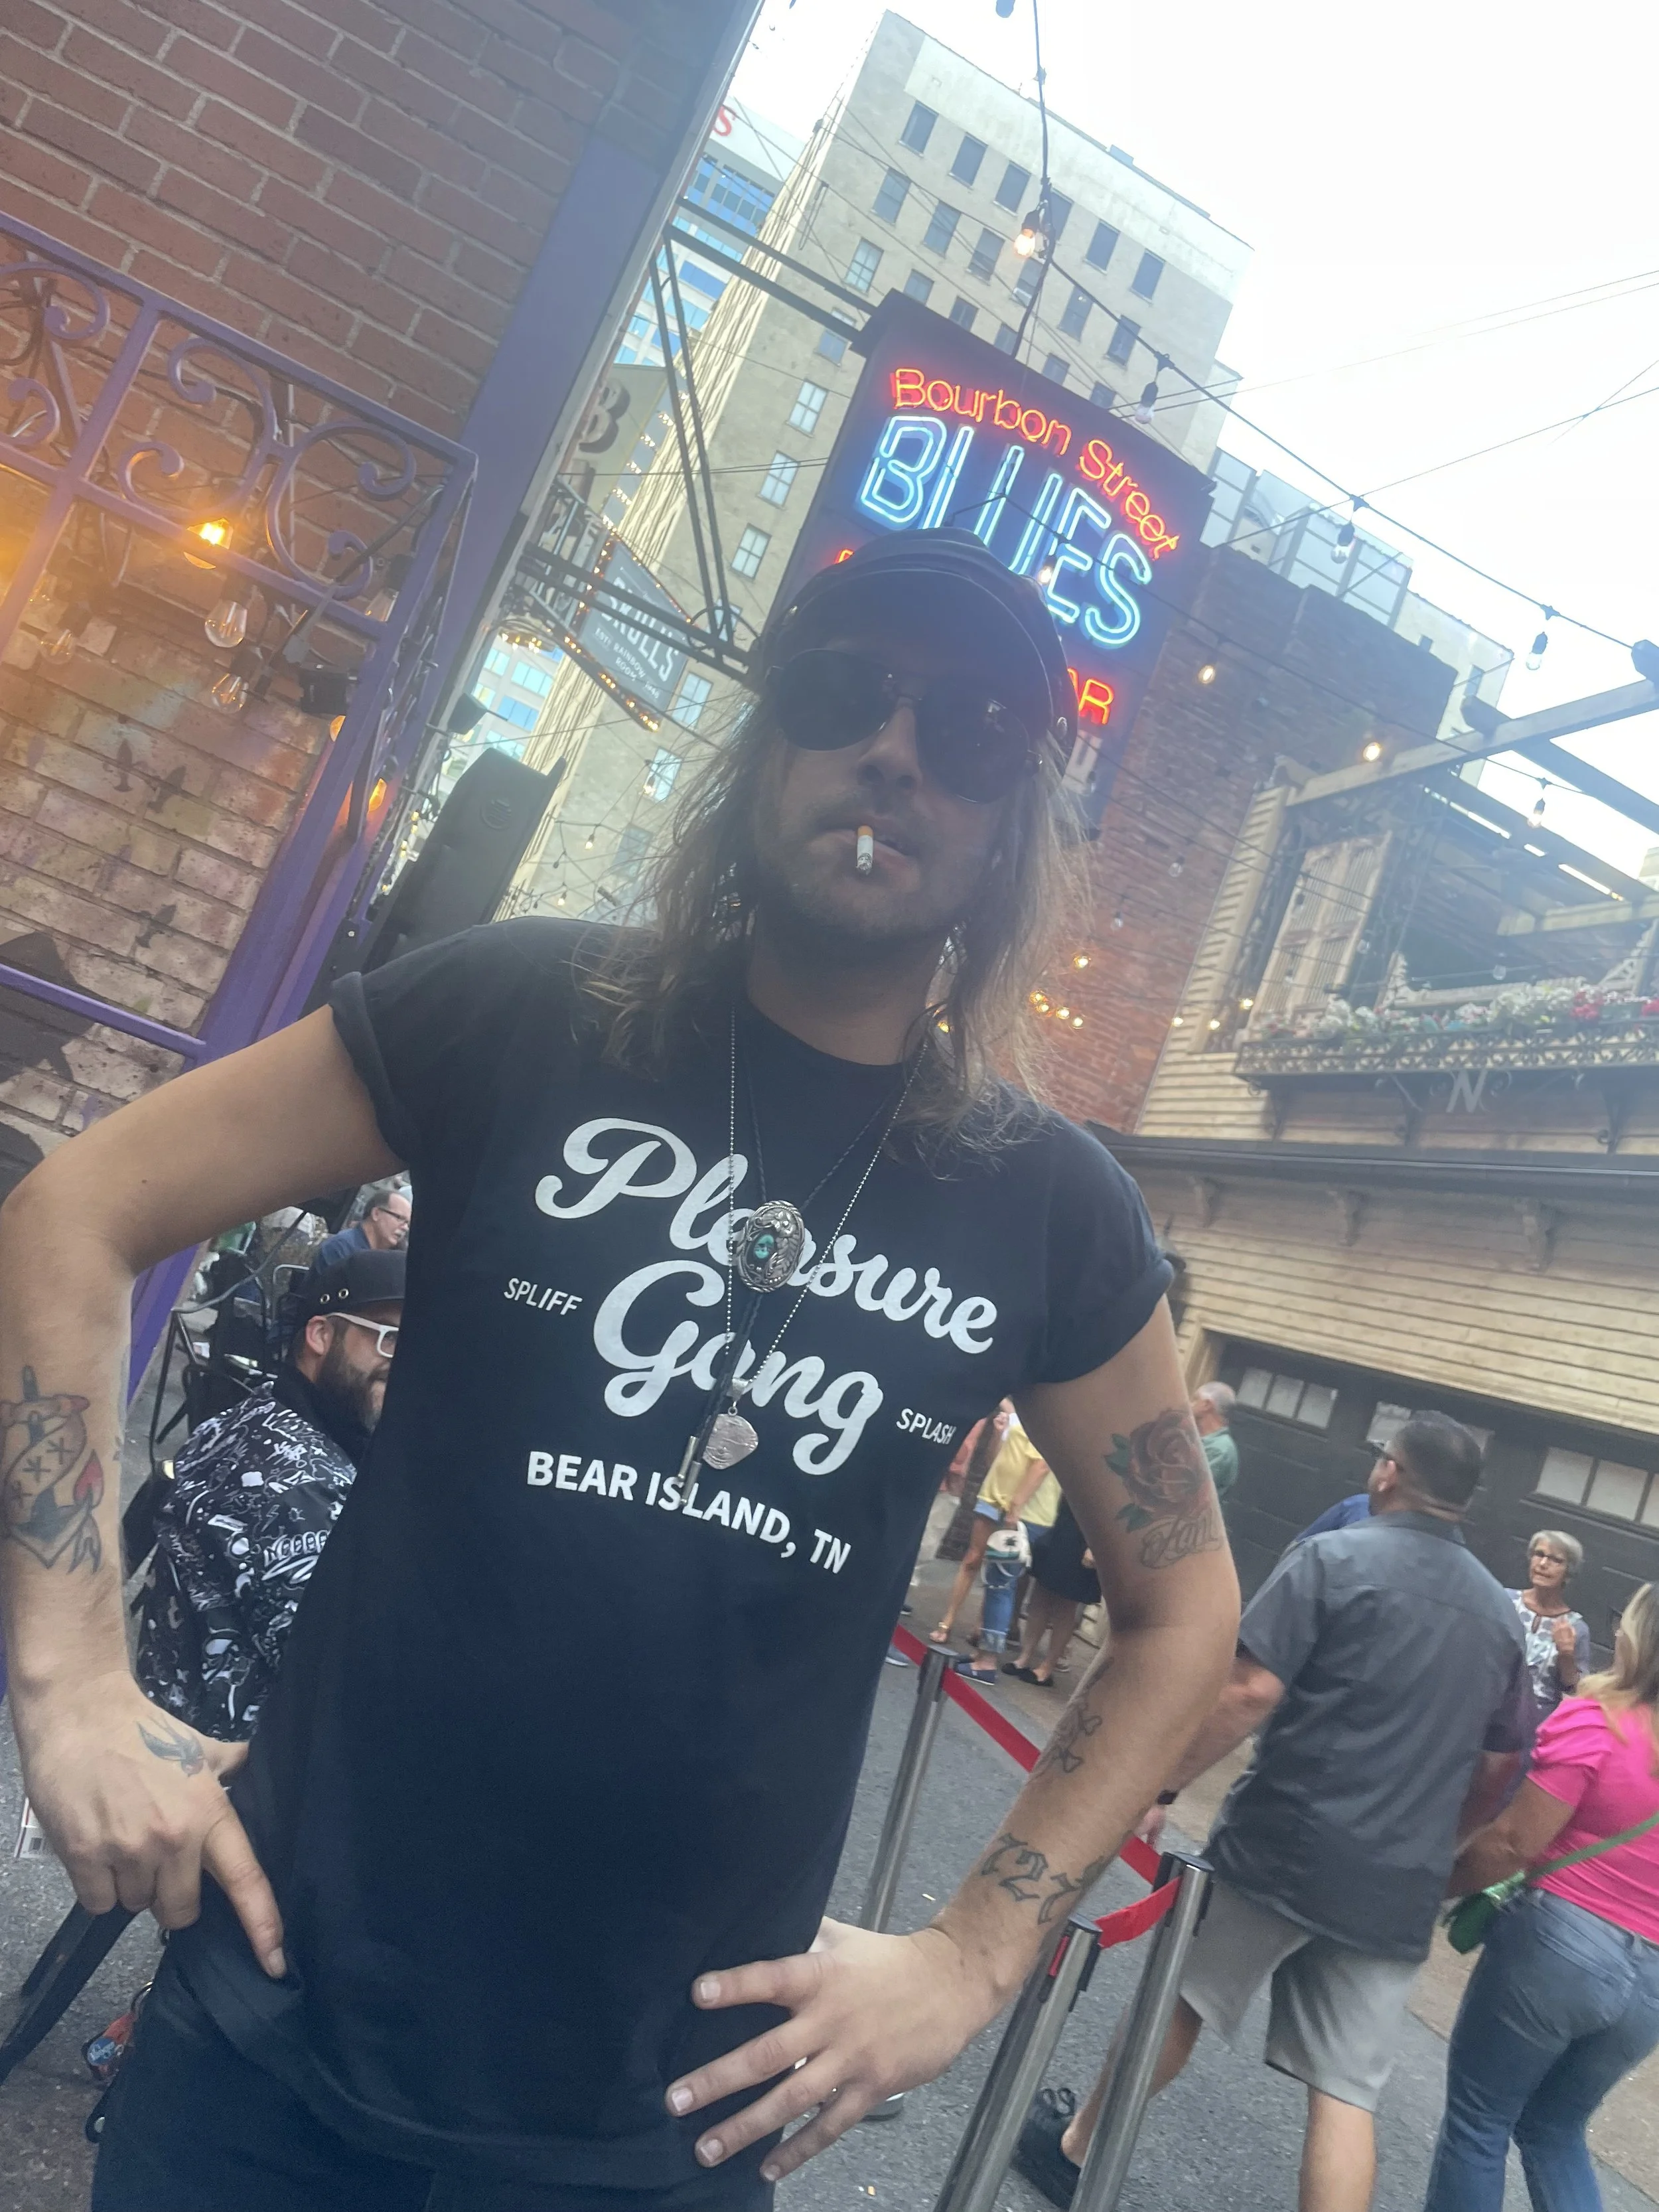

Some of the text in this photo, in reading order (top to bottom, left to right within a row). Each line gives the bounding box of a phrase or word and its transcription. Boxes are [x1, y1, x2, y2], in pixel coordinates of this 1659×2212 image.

[891, 368, 1180, 559] Bourbon Street
[504, 1278, 583, 1315] SPLIFF
[534, 1118, 998, 1355] Plesure
[593, 1260, 884, 1476] Gang
[896, 1408, 957, 1445] SPLASH
[527, 1451, 852, 1574] BEAR ISLAND, TN
